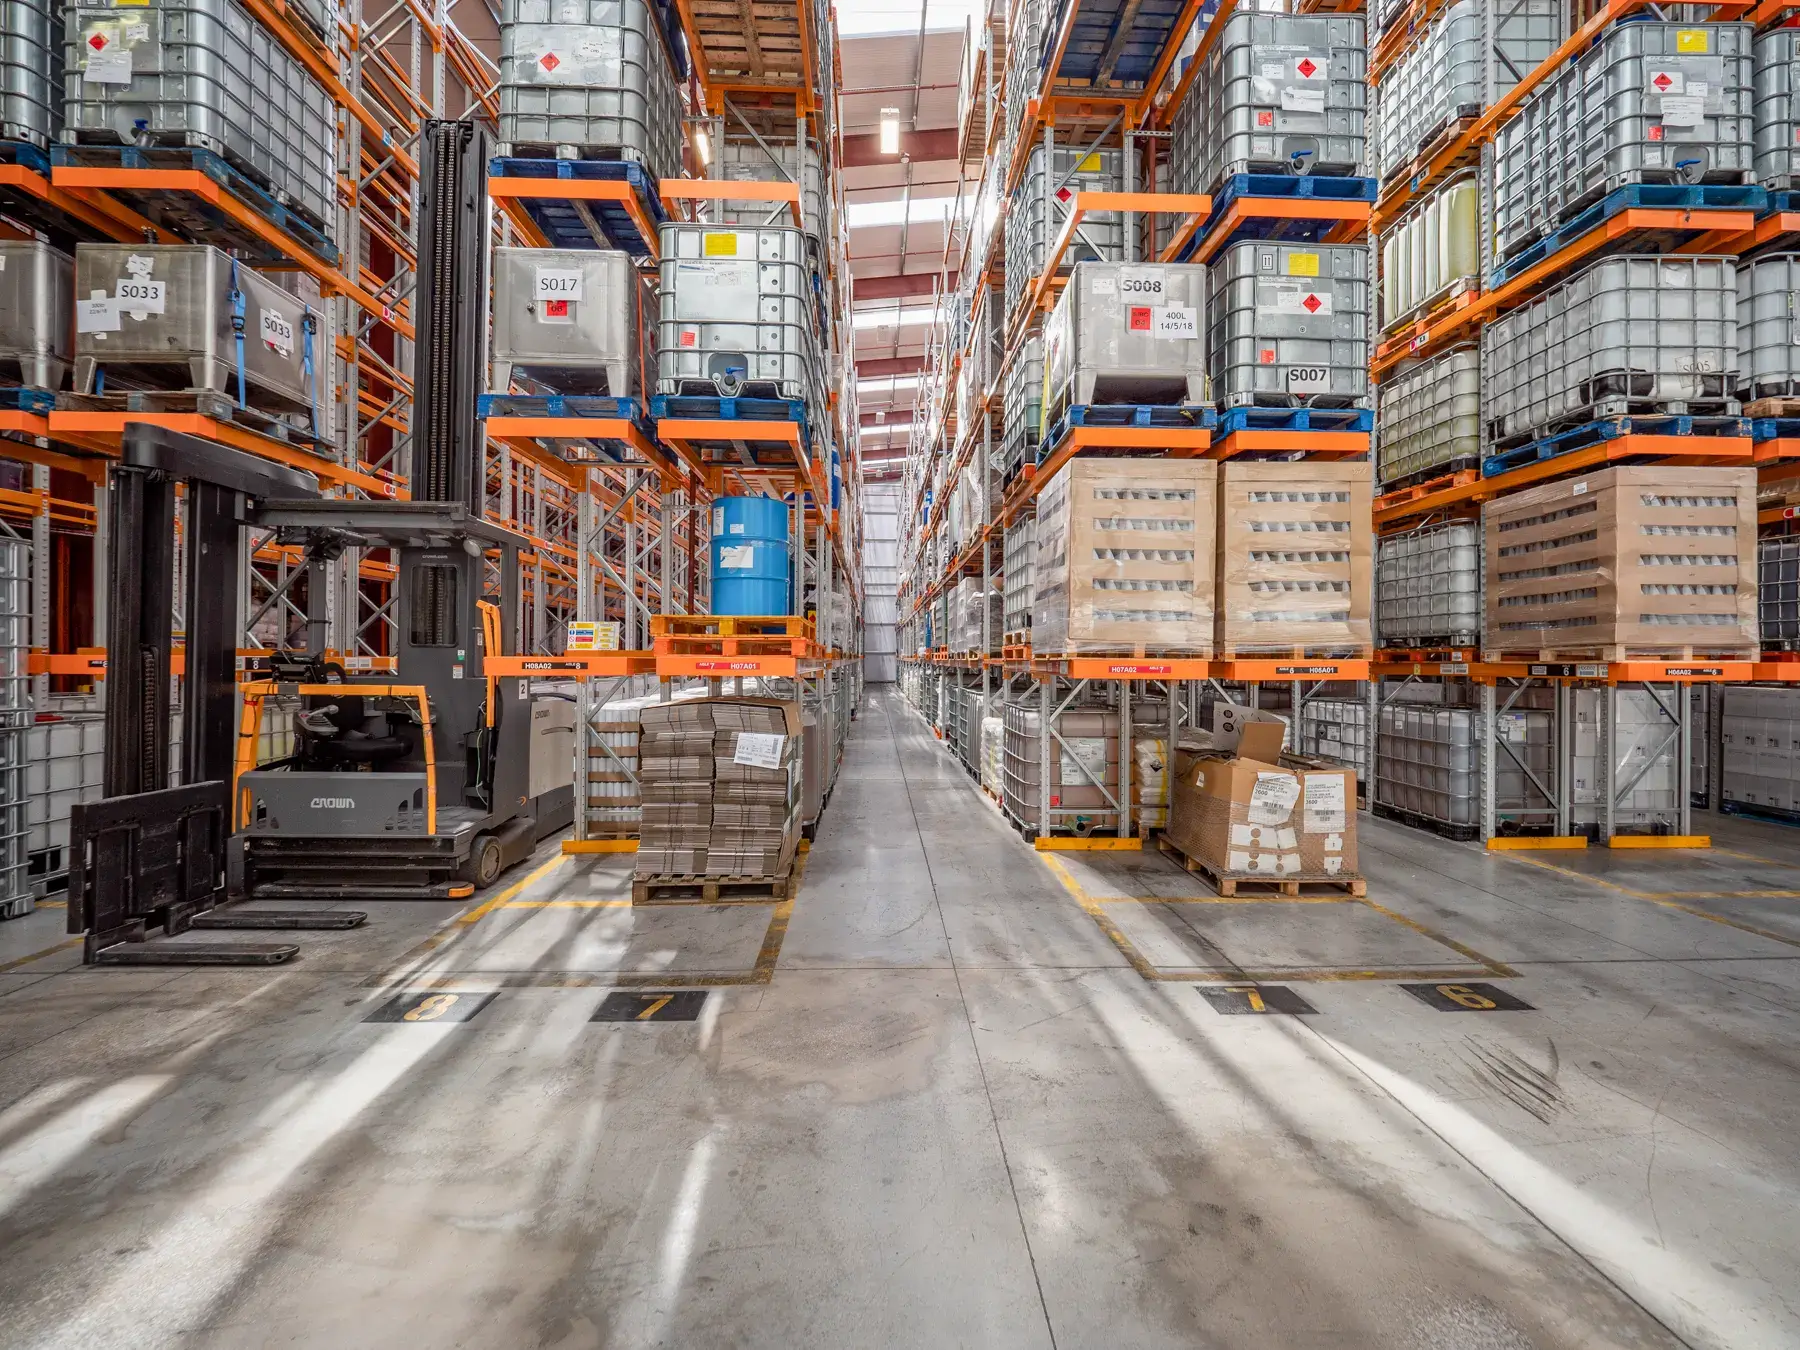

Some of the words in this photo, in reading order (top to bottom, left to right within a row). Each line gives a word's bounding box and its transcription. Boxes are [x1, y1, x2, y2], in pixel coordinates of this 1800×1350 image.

[540, 277, 578, 291] S017
[1123, 279, 1162, 293] S008
[121, 284, 159, 300] S033
[1166, 312, 1187, 320] 400L
[264, 316, 290, 339] S033
[1160, 322, 1193, 330] 14/5/18
[1290, 368, 1327, 381] S007
[253, 660, 259, 669] 8
[575, 662, 581, 670] 8
[1563, 667, 1570, 676] 6
[520, 683, 526, 694] 2
[310, 797, 355, 809] CROWN
[1224, 987, 1266, 1012] 7
[1436, 984, 1497, 1009] 6
[403, 994, 459, 1021] 8
[635, 994, 675, 1019] 7
